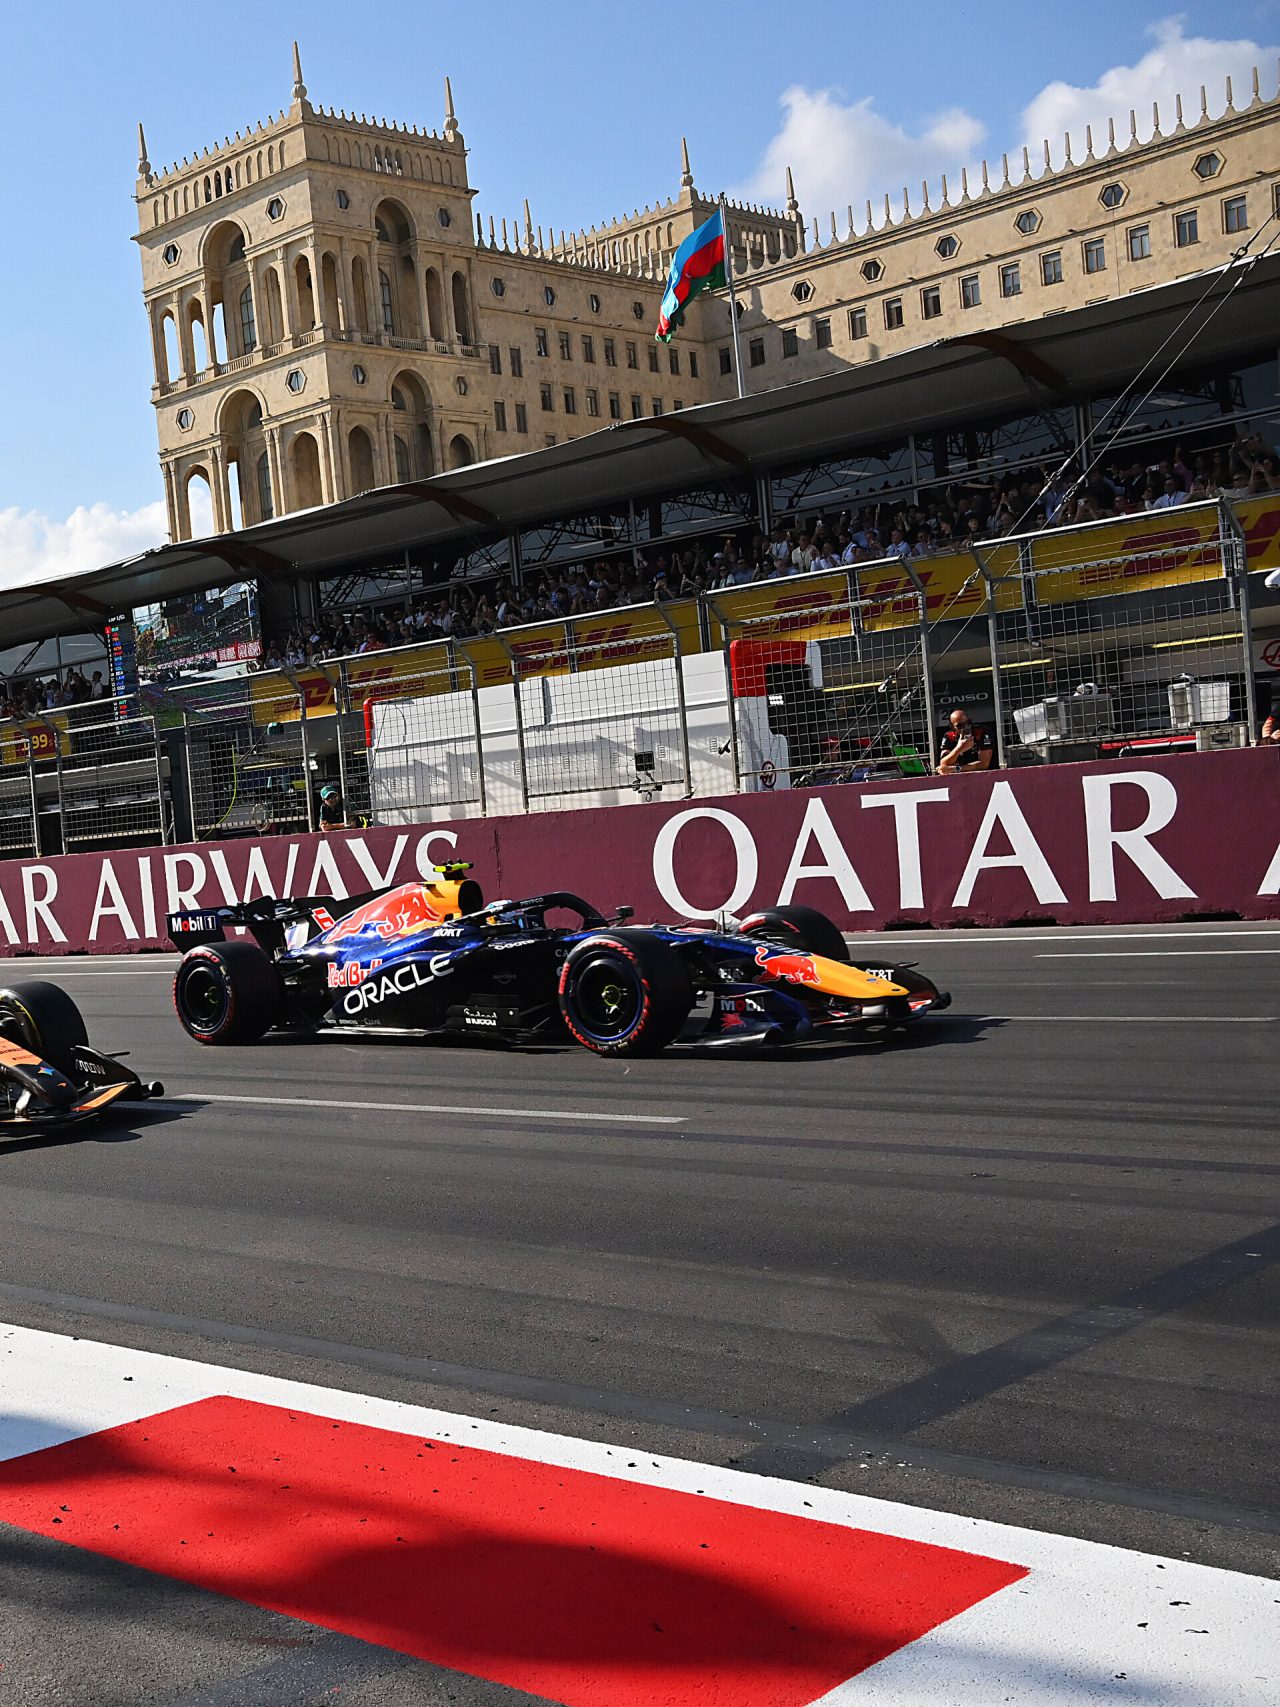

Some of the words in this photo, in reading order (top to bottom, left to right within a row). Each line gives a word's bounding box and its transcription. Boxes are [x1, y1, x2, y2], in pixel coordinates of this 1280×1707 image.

[772, 571, 946, 633] DHL
[652, 771, 1198, 923] QATAR
[172, 917, 204, 932] Mobil
[328, 961, 348, 987] Red
[343, 952, 455, 1014] ORACLE
